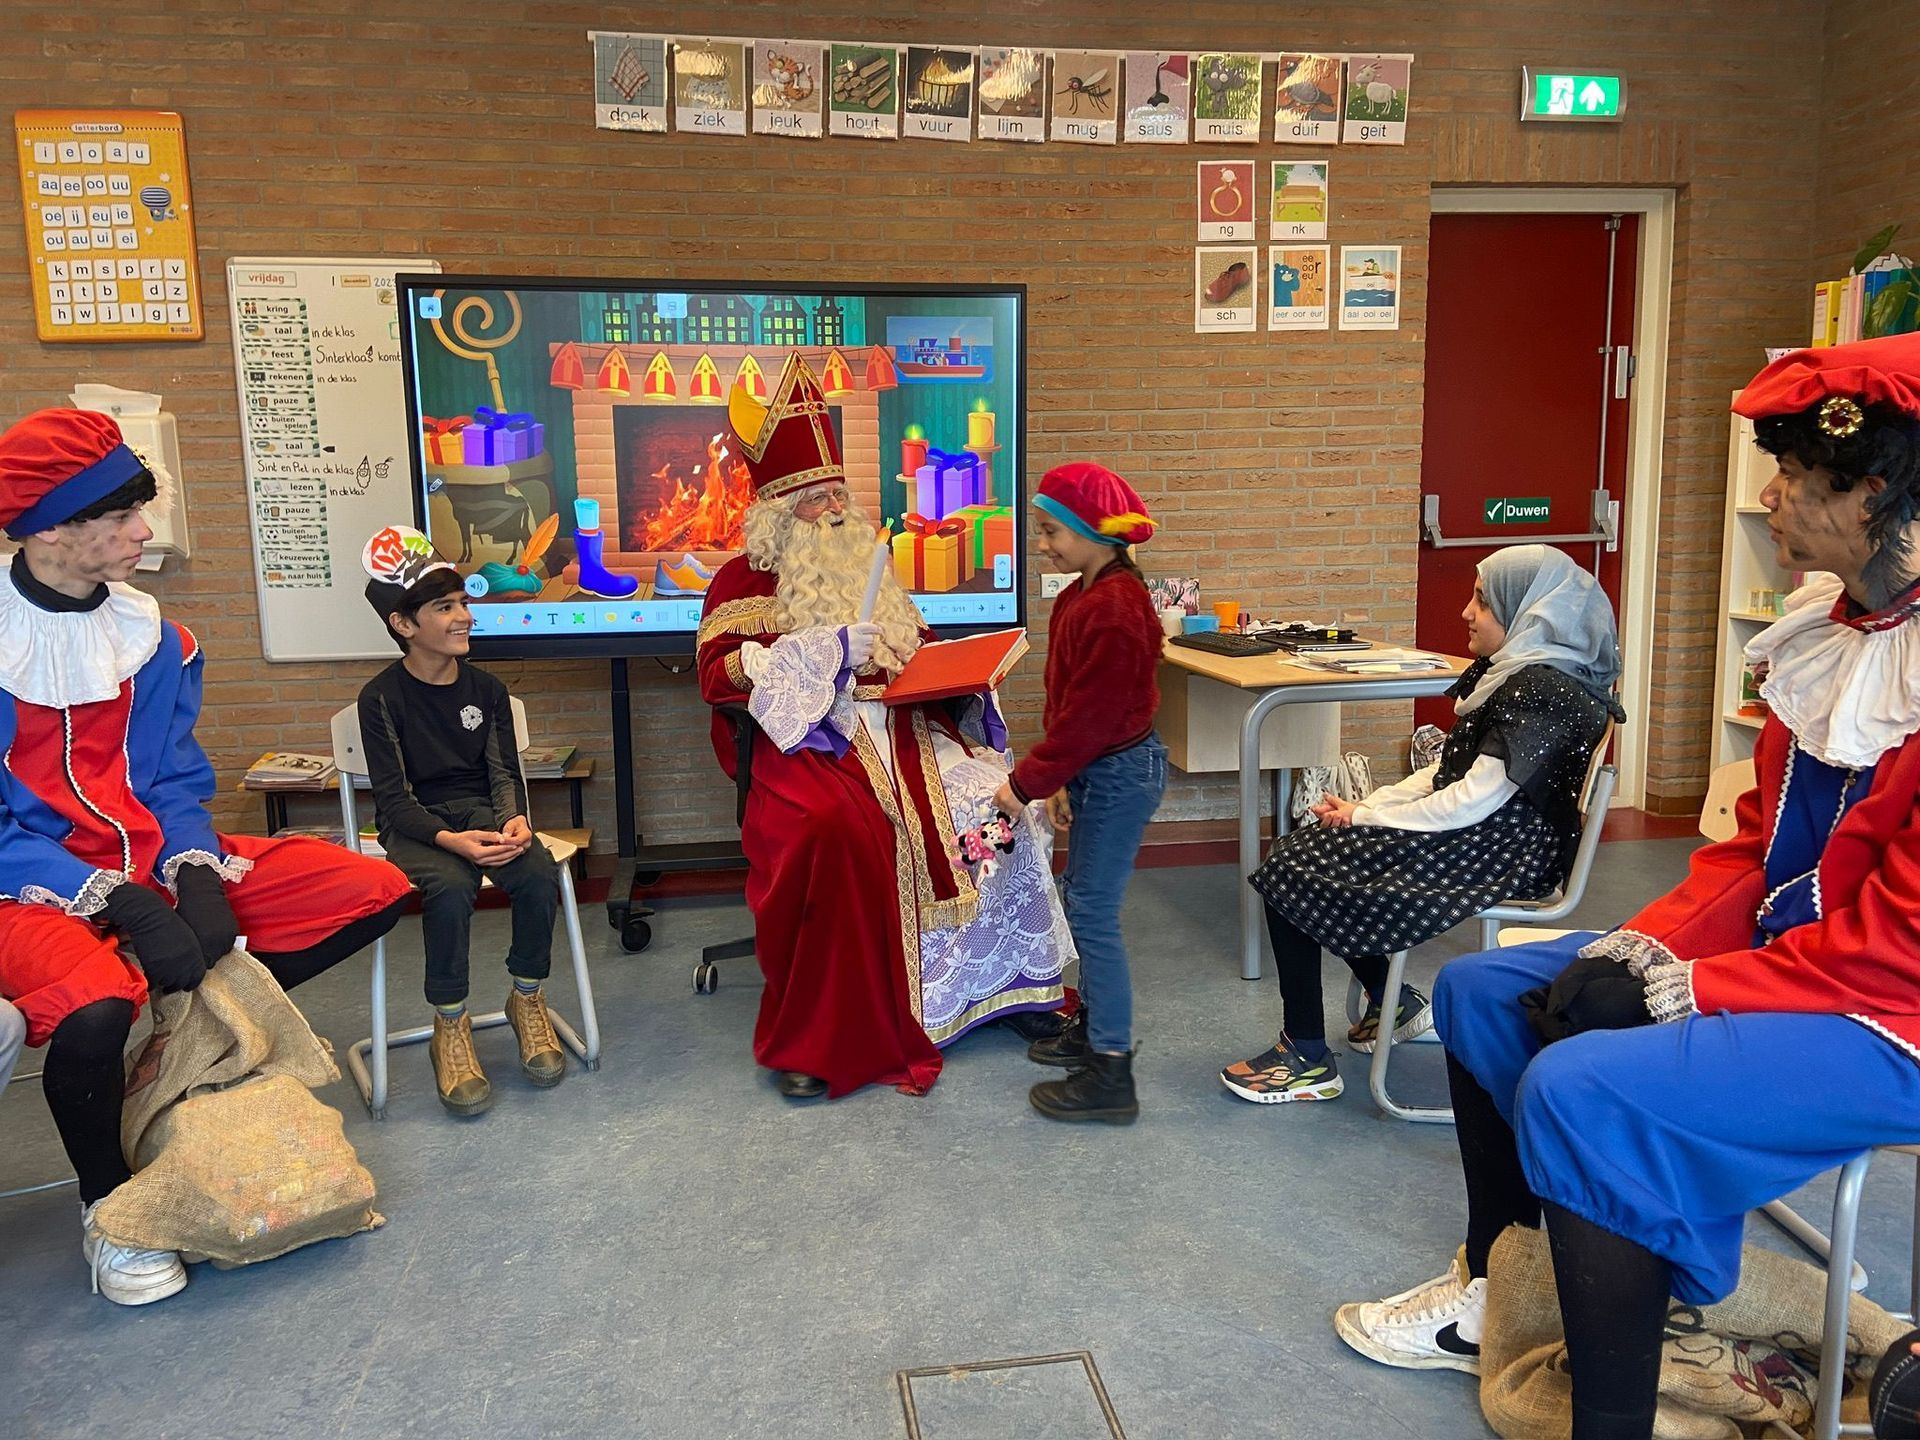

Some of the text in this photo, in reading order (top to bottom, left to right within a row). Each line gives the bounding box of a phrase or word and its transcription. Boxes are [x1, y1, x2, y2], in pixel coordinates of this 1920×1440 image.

[610, 108, 649, 122] doek
[694, 113, 725, 127] ziek
[770, 114, 802, 129] jeuk
[846, 115, 879, 128] hout
[919, 120, 952, 132] vuur
[998, 120, 1024, 136] lijm
[1066, 123, 1098, 139] mug
[1138, 124, 1172, 135] saus
[1209, 122, 1243, 134] muis
[1292, 122, 1319, 136] duif
[1360, 123, 1386, 140] geit
[66, 149, 74, 157] e
[88, 150, 96, 158] o
[114, 148, 121, 156] a
[42, 181, 58, 190] aa
[64, 183, 80, 191] ee
[87, 180, 104, 189] oo
[45, 208, 128, 224] oe ij eu ie
[1220, 224, 1234, 236] ng
[1292, 224, 1305, 234] nk
[47, 236, 63, 245] ou
[97, 232, 108, 242] ui
[122, 233, 133, 243] ei
[55, 266, 62, 275] k
[126, 266, 133, 276] p
[249, 274, 285, 284] vrijdag
[104, 286, 112, 296] b
[150, 285, 158, 295] d
[58, 309, 66, 318] h
[152, 310, 160, 320] g
[1216, 310, 1236, 320] sch
[312, 326, 355, 338] in de klas
[316, 345, 401, 364] Sinterklaas komt
[258, 460, 277, 472] Sint
[323, 464, 333, 474] de
[335, 464, 354, 475] klas
[1507, 505, 1548, 516] Duwen
